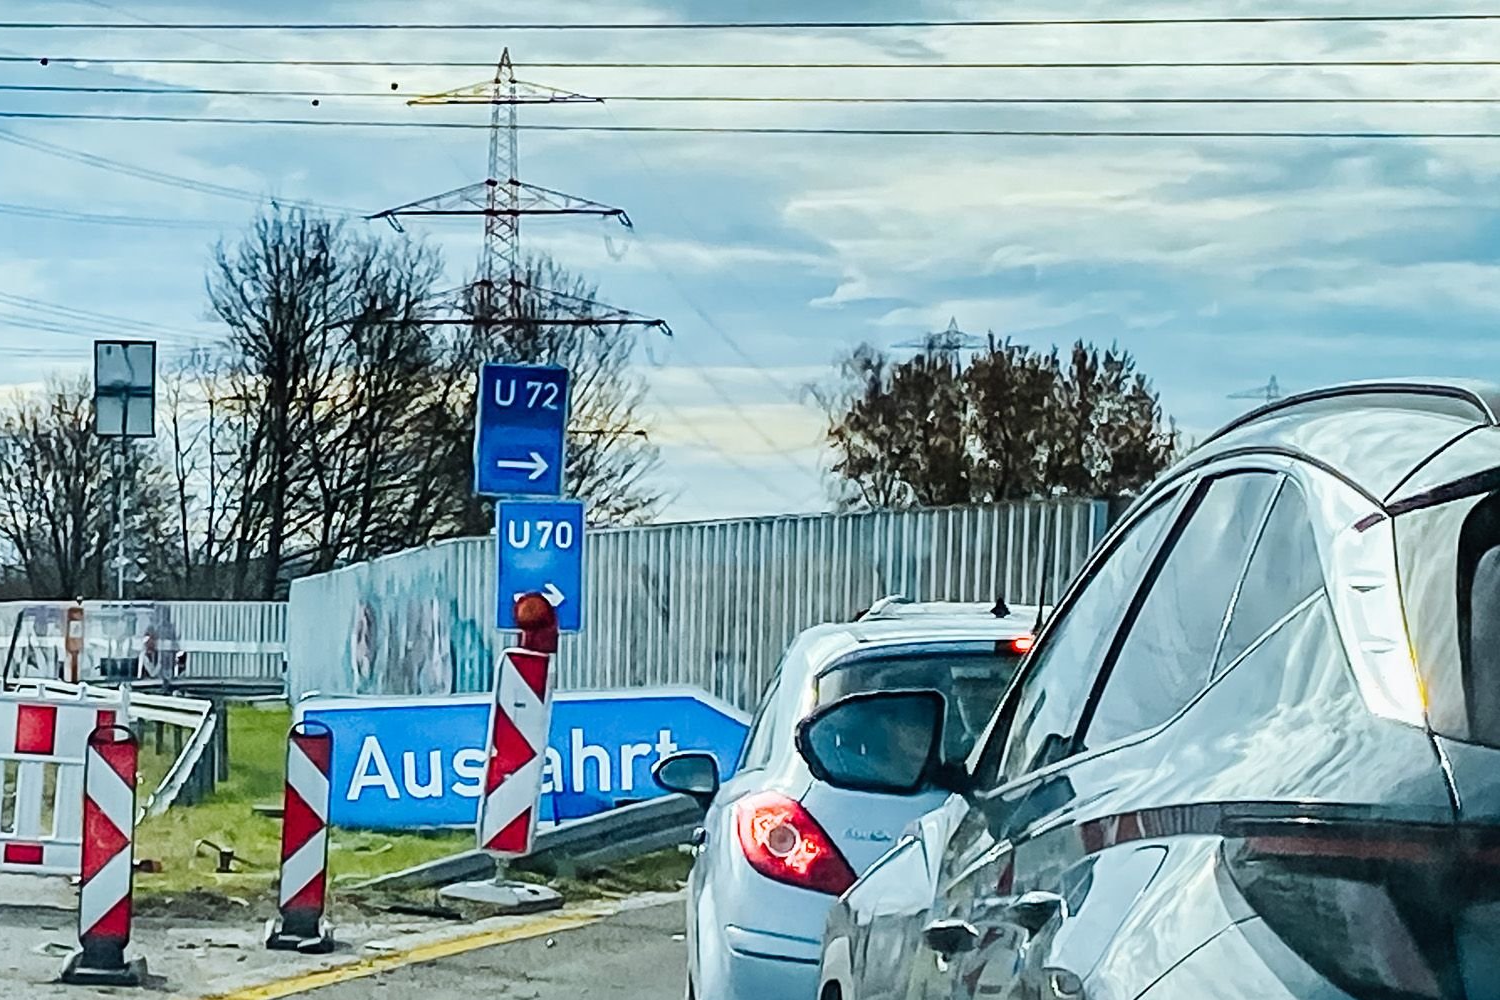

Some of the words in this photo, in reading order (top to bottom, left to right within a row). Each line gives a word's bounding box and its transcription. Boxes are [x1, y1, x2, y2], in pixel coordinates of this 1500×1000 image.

[495, 379, 516, 406] U
[526, 381, 559, 410] 72
[508, 520, 530, 549] U
[536, 520, 573, 549] 70
[346, 728, 678, 801] Ausahrt
